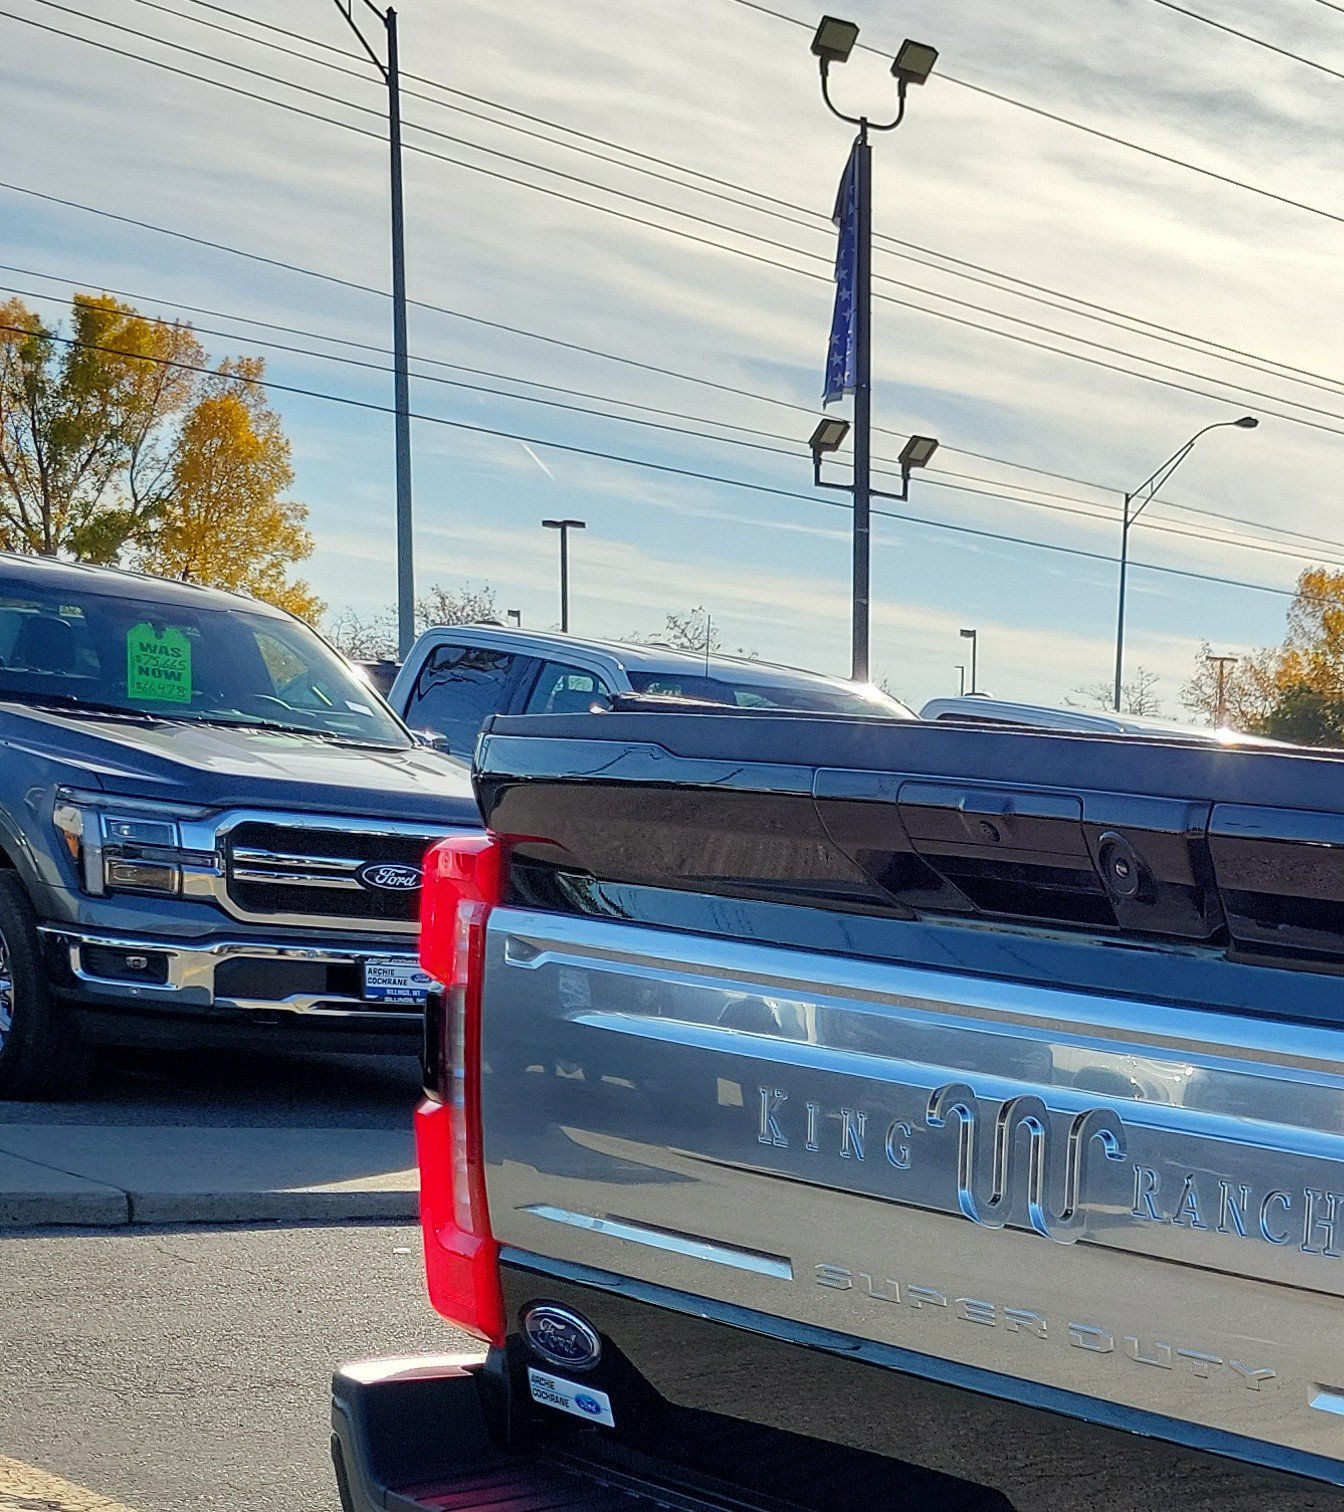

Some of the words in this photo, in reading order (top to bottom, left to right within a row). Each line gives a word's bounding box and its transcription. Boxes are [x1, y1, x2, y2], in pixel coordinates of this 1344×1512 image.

[140, 642, 182, 658] WAS
[138, 665, 183, 681] NOW
[375, 868, 416, 887] Ford
[367, 967, 395, 976] ARCHIE
[367, 976, 408, 986] COCHRANE
[757, 1086, 912, 1170] KING
[1131, 1163, 1344, 1259] RANCH
[815, 1262, 1049, 1340] SUPER
[1068, 1320, 1277, 1391] DUTY
[537, 1318, 579, 1355] Ford
[531, 1374, 555, 1391] ARCHIE
[532, 1387, 570, 1409] COCHRANE
